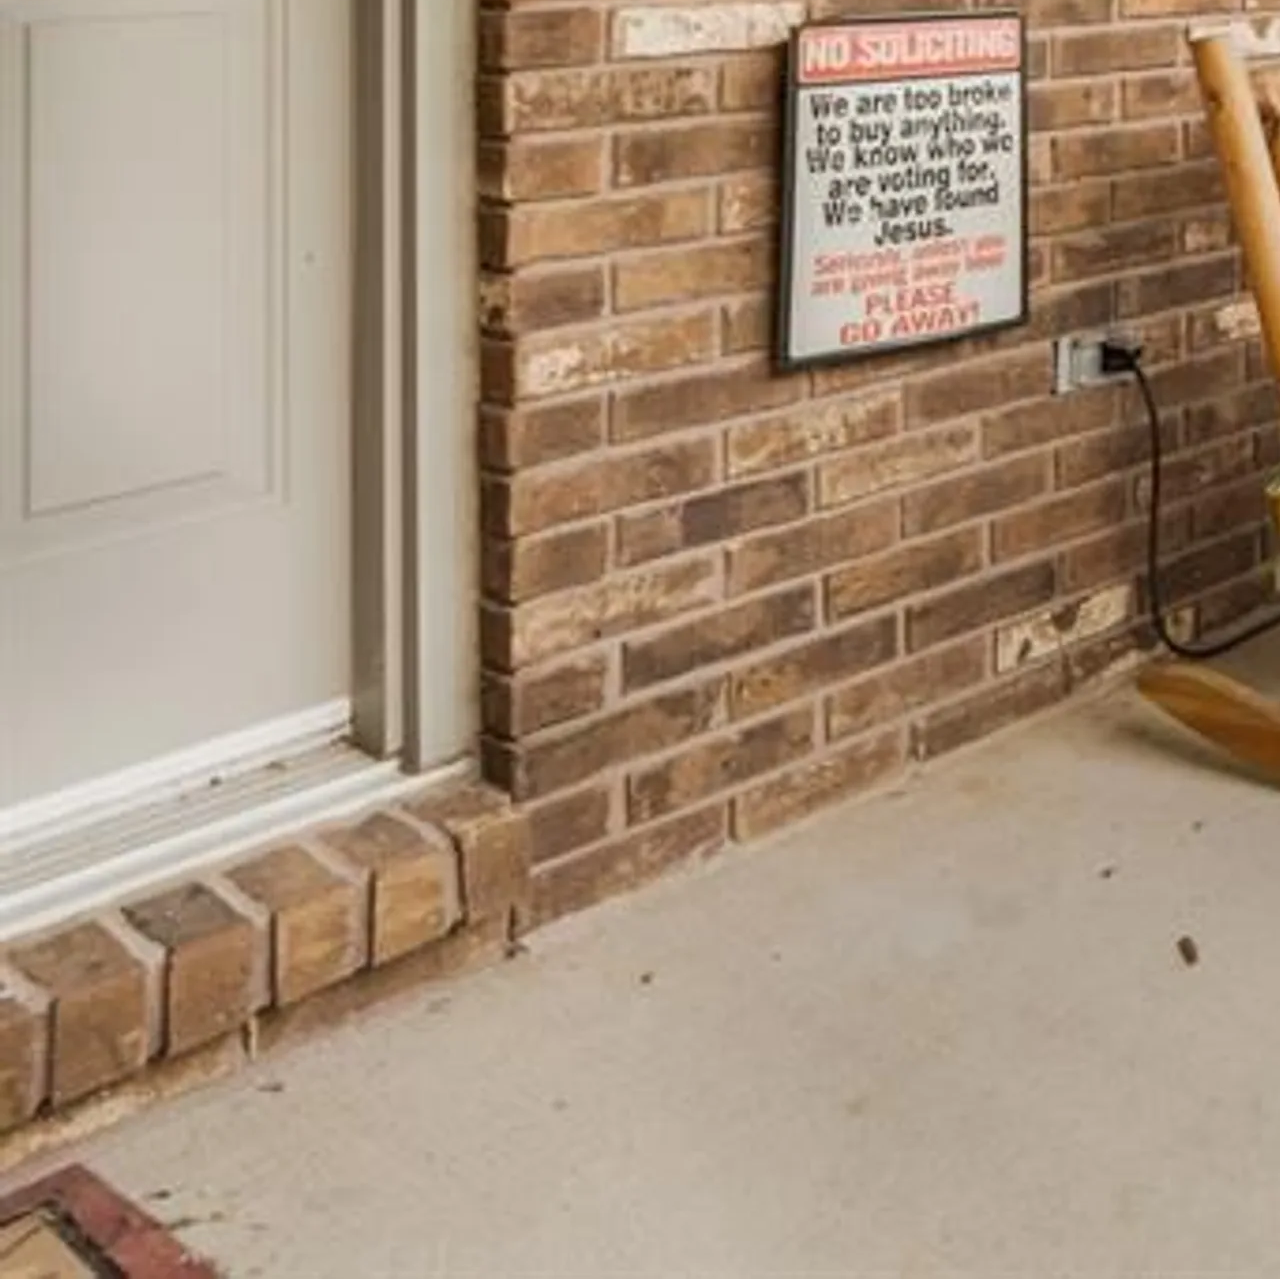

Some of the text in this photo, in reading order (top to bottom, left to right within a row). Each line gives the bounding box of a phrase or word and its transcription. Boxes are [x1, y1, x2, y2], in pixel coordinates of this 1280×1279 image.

[805, 29, 1017, 72] NO SOLICITING
[809, 80, 1012, 119] We are too broke
[817, 109, 1006, 146] to buy anything.
[806, 133, 1014, 174] We know who we
[829, 176, 871, 200] are
[878, 165, 950, 193] voting
[822, 182, 999, 227] We have found
[874, 218, 954, 246] Jesus.
[865, 283, 955, 316] PLEASE
[839, 321, 882, 345] GO
